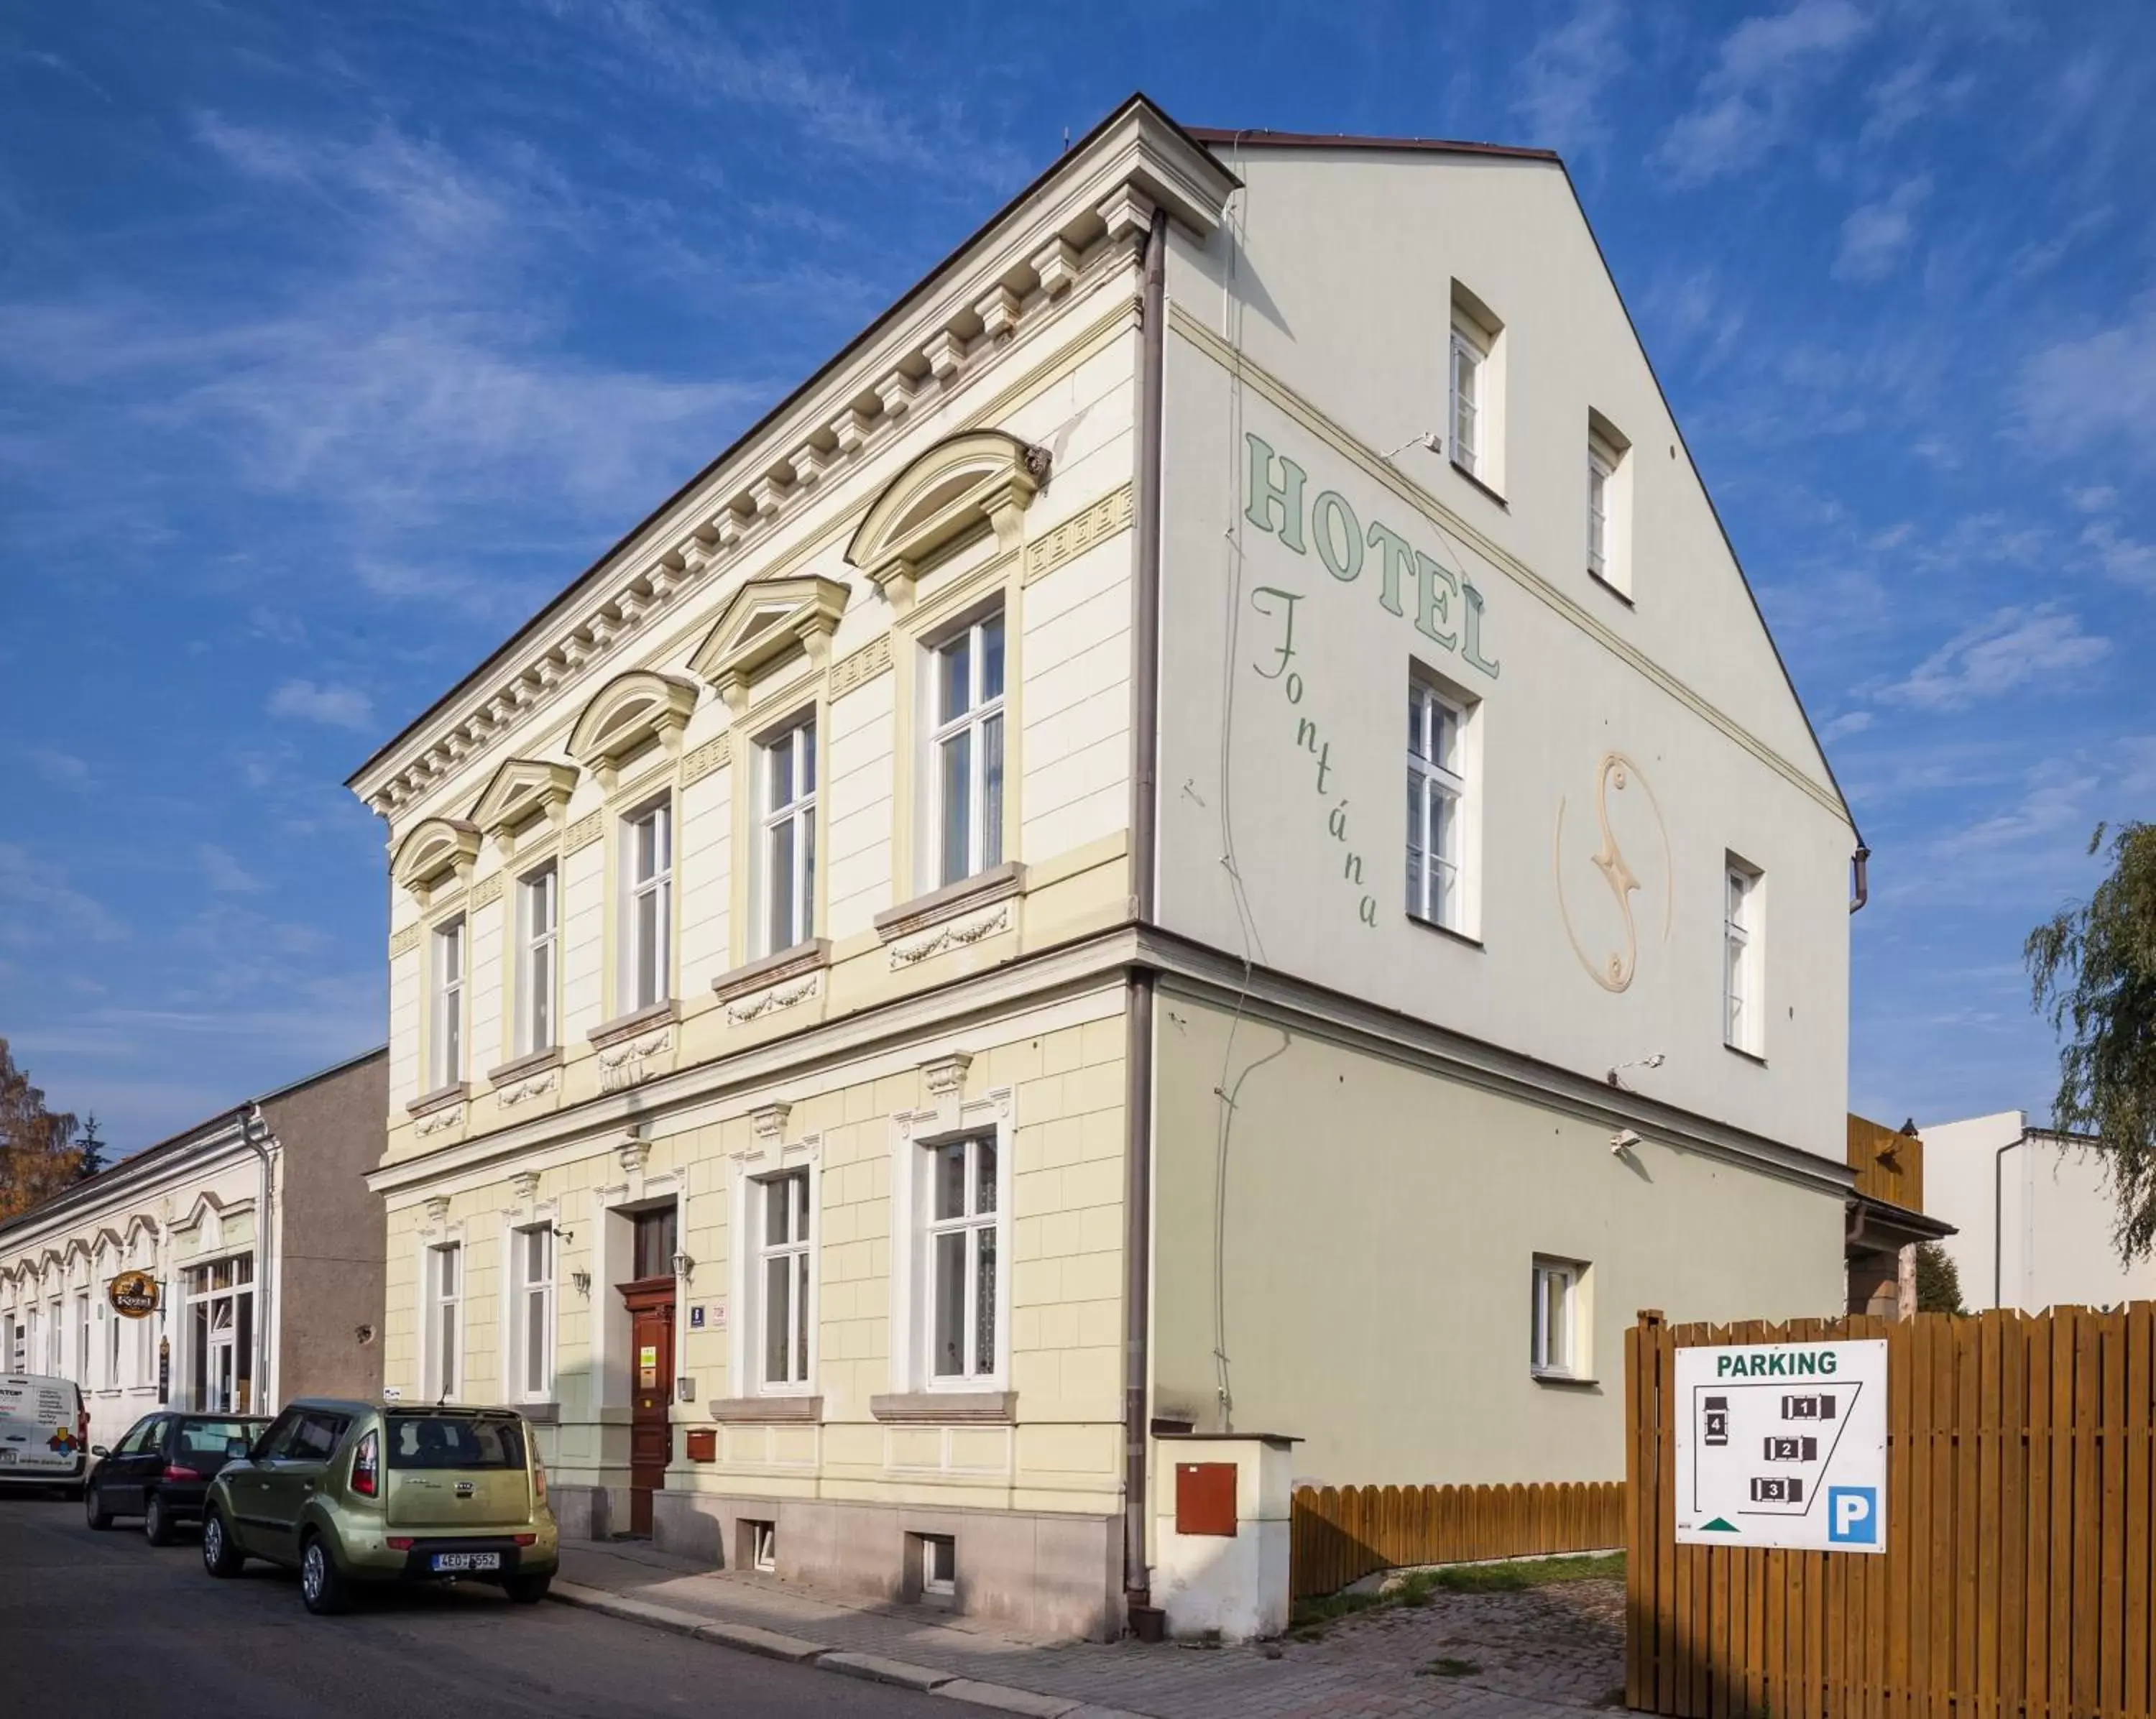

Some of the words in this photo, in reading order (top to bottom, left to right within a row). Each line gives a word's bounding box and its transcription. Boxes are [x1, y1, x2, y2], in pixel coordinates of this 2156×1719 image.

[1245, 433, 1500, 679] HOTEL
[1251, 586, 1377, 927] Fontána
[1717, 1351, 1837, 1377] PARKING
[1800, 1402, 1807, 1414] 1
[1711, 1418, 1720, 1431] 4
[1782, 1443, 1792, 1455] 2
[1769, 1484, 1779, 1496] 3
[1835, 1494, 1869, 1535] P
